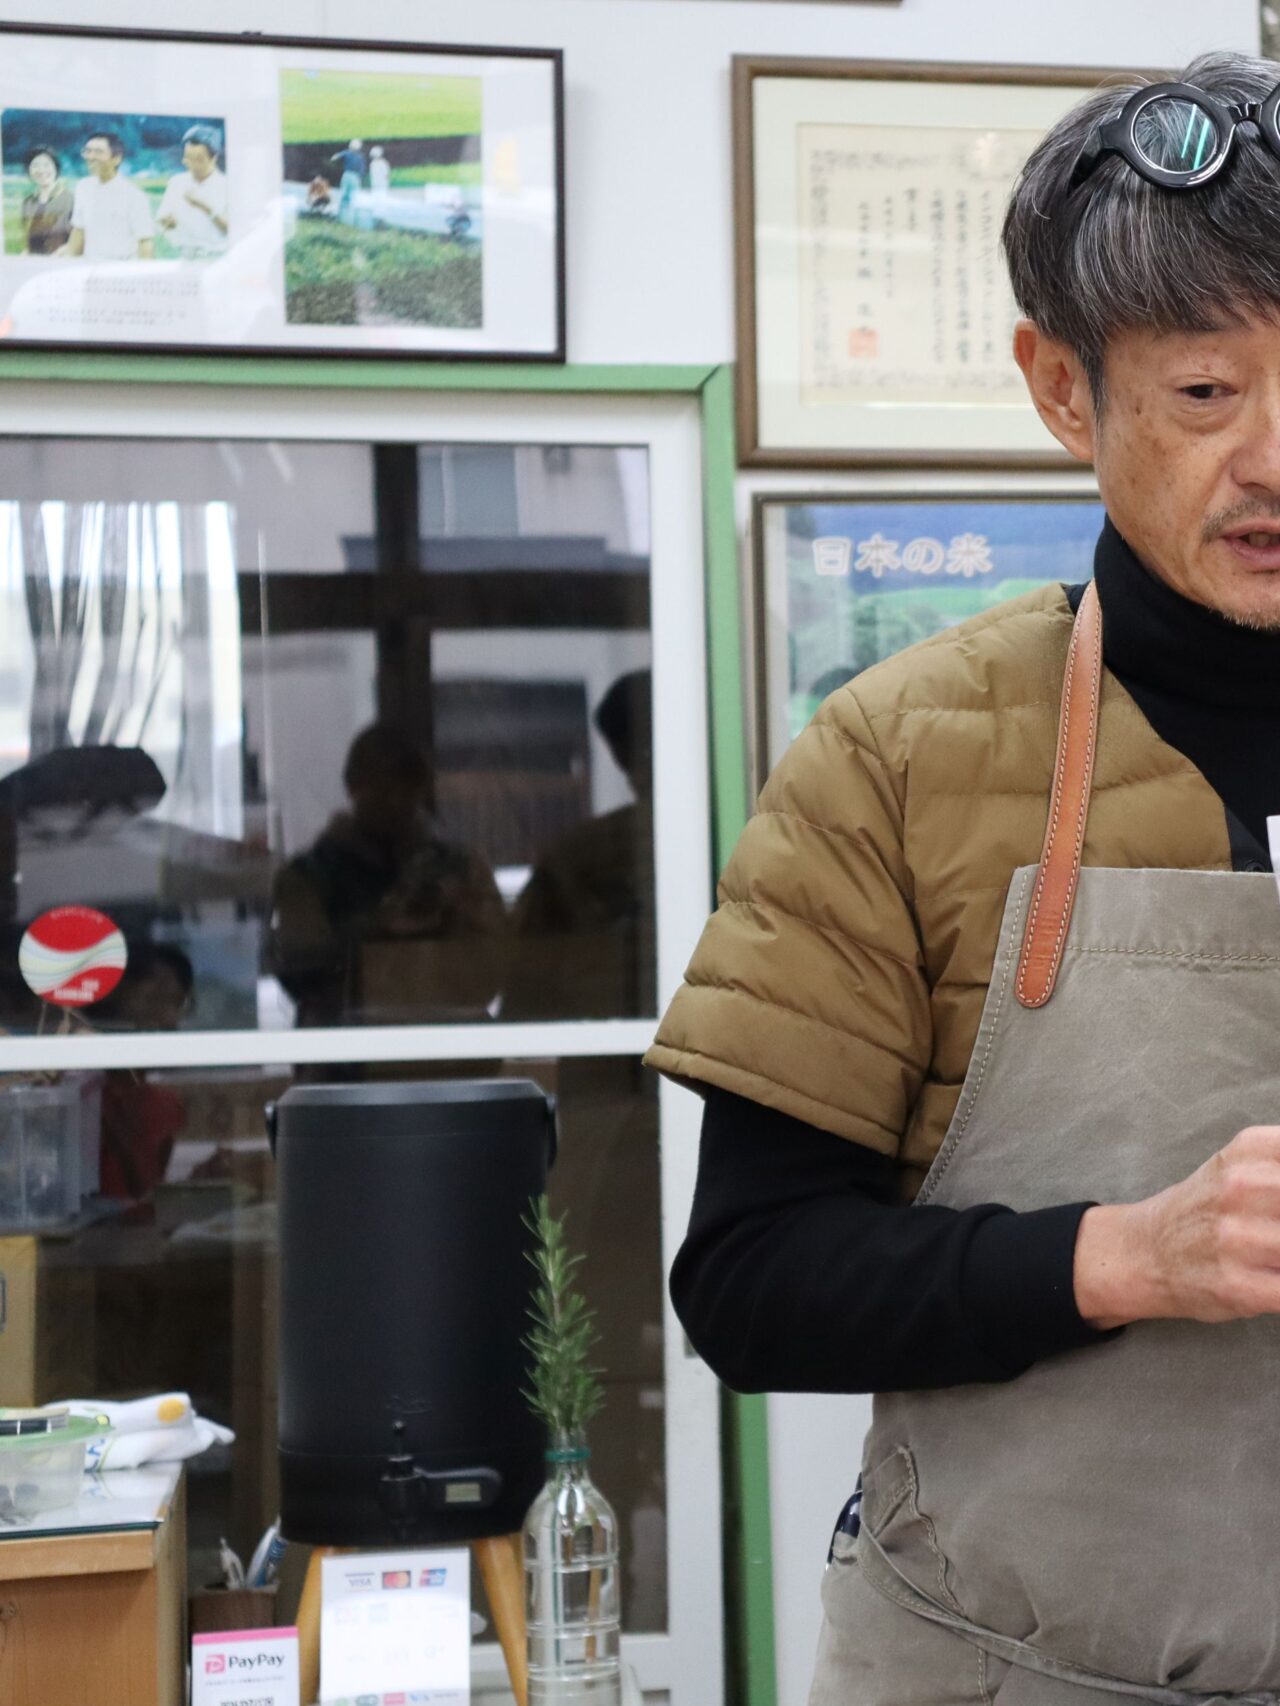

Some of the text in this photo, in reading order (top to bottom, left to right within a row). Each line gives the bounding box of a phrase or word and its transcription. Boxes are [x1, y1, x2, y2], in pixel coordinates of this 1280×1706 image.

[812, 533, 993, 578] 日本の米
[228, 1653, 285, 1670] PayPay
